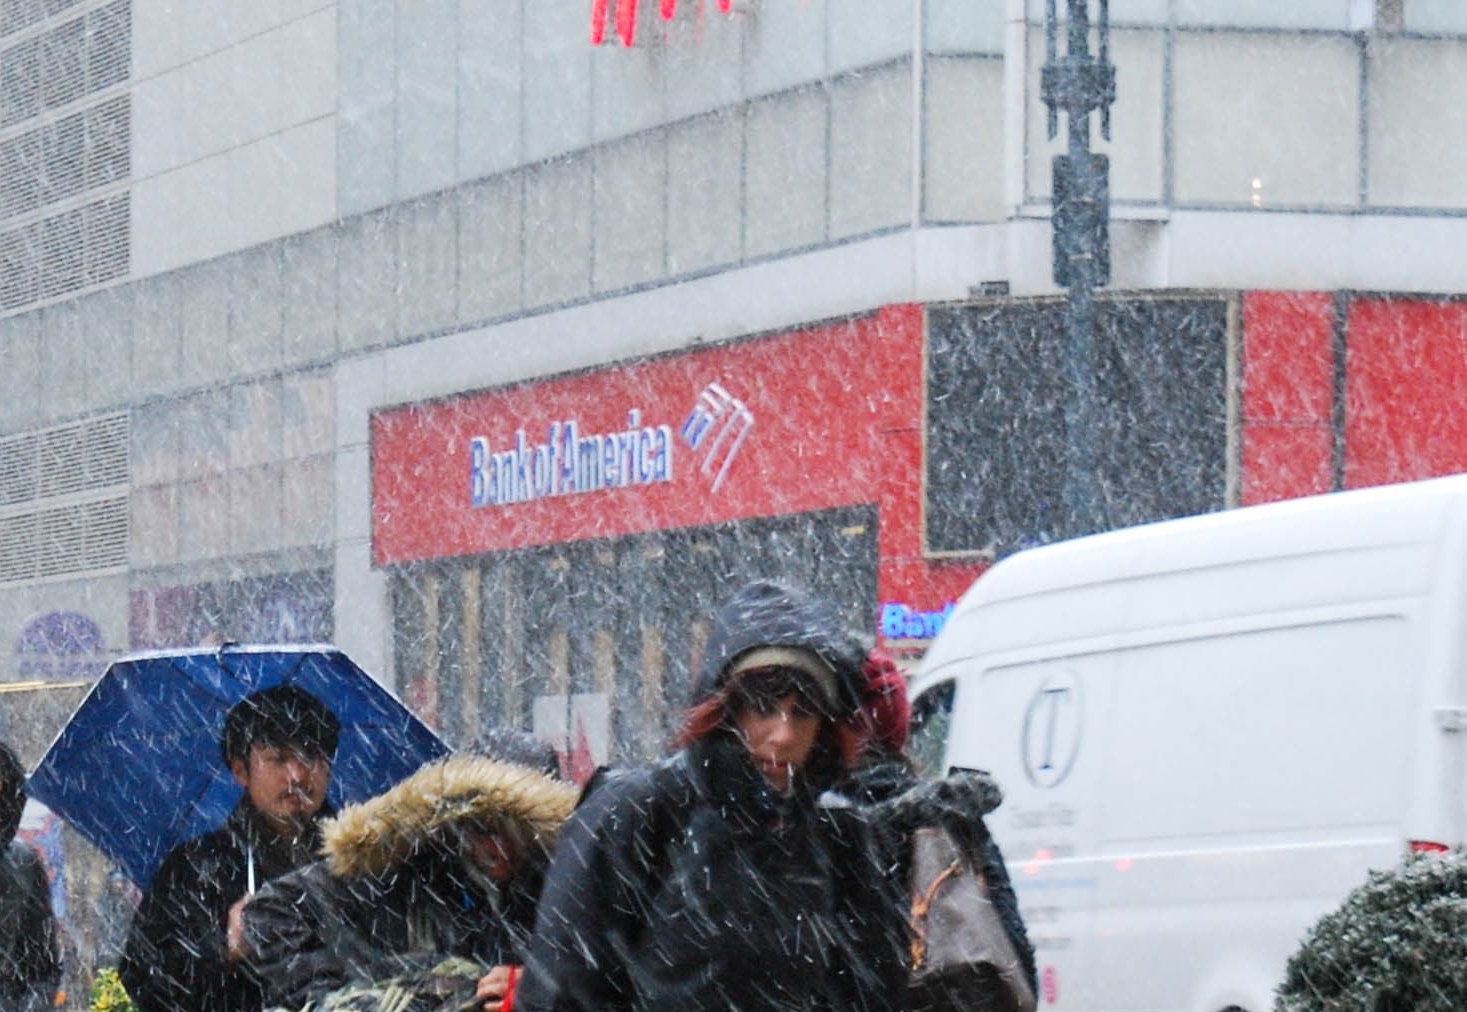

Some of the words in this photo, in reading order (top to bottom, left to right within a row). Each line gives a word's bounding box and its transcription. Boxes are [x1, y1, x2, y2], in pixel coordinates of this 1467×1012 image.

[470, 428, 533, 508] Bank
[534, 420, 562, 498] of
[560, 408, 675, 495] America
[881, 601, 955, 639] Ban
